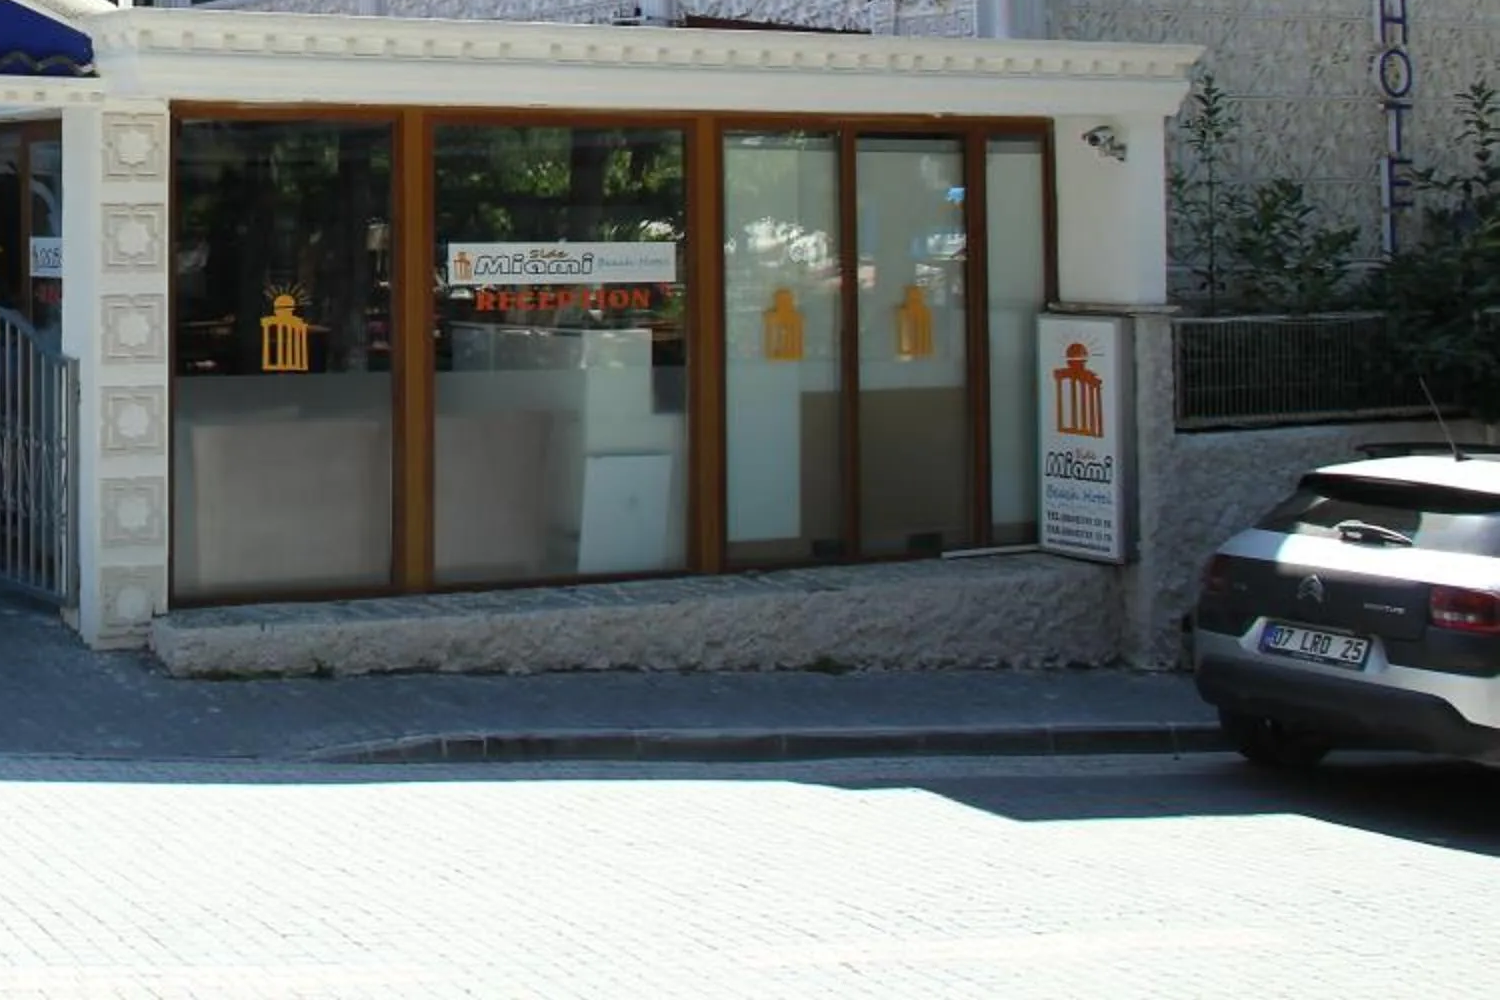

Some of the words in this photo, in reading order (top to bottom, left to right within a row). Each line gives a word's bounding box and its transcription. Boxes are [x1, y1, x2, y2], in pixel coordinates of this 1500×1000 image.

[474, 253, 594, 275] Miami
[1045, 451, 1113, 484] Miami
[1340, 639, 1365, 661] 25
